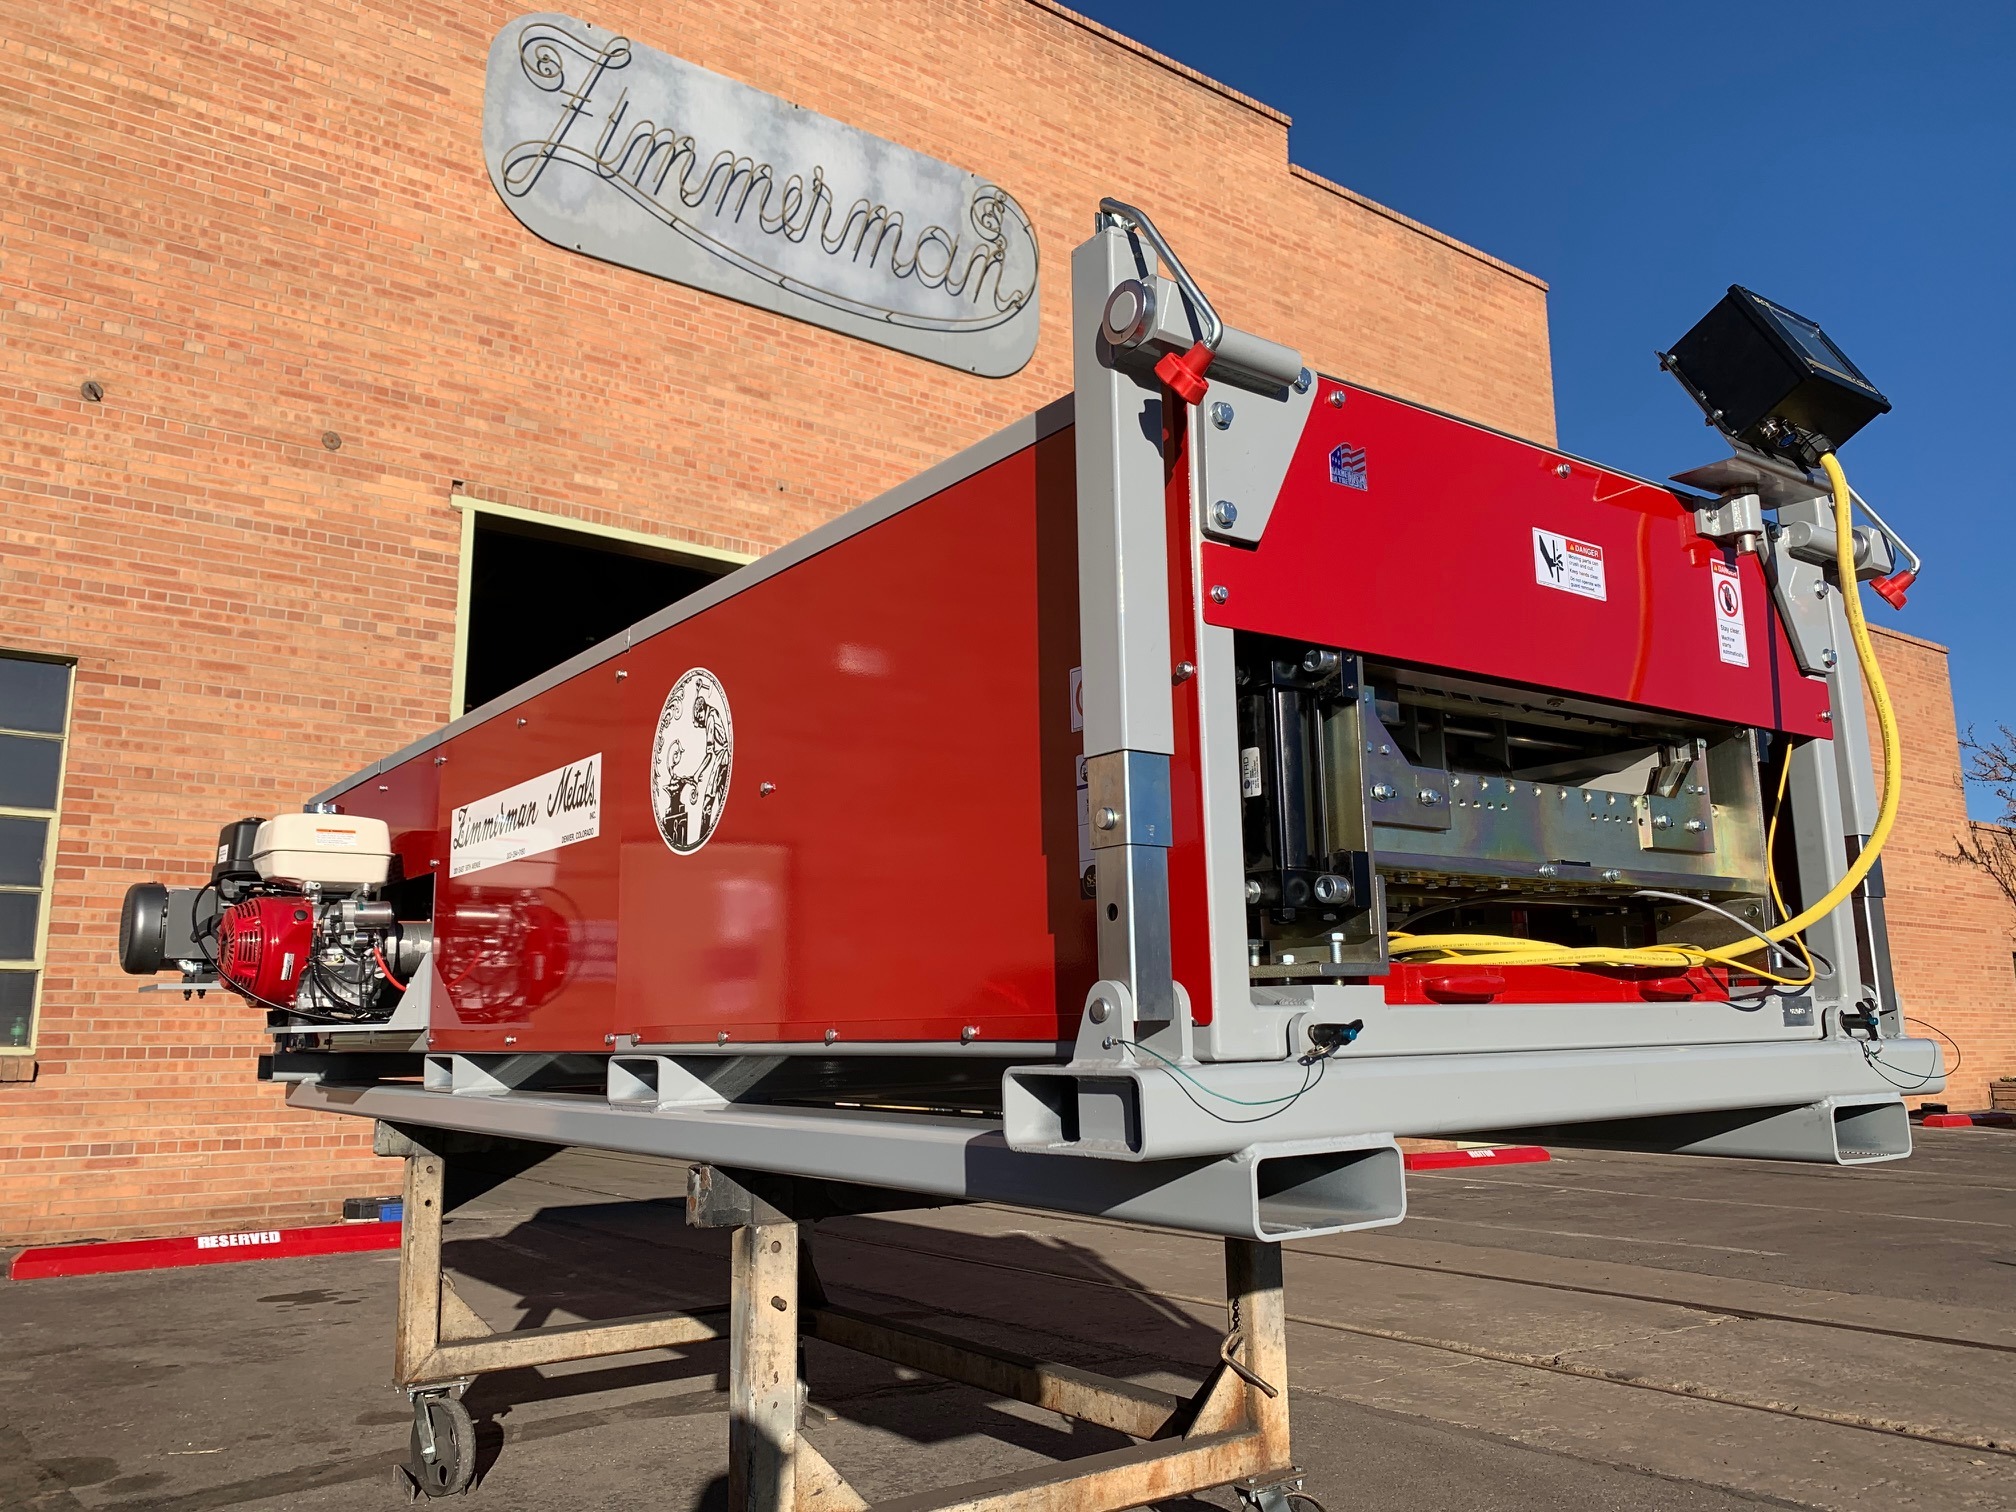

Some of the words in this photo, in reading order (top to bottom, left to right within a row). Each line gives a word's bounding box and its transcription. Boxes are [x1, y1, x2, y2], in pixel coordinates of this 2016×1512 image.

[502, 23, 1036, 322] Zimmerman
[1568, 554, 1581, 562] Moving
[1574, 545, 1599, 558] DANGER
[1720, 624, 1729, 633] Stay
[453, 801, 539, 850] Zimmerman
[575, 827, 595, 840] COLORADO
[197, 1231, 281, 1249] RESERVED
